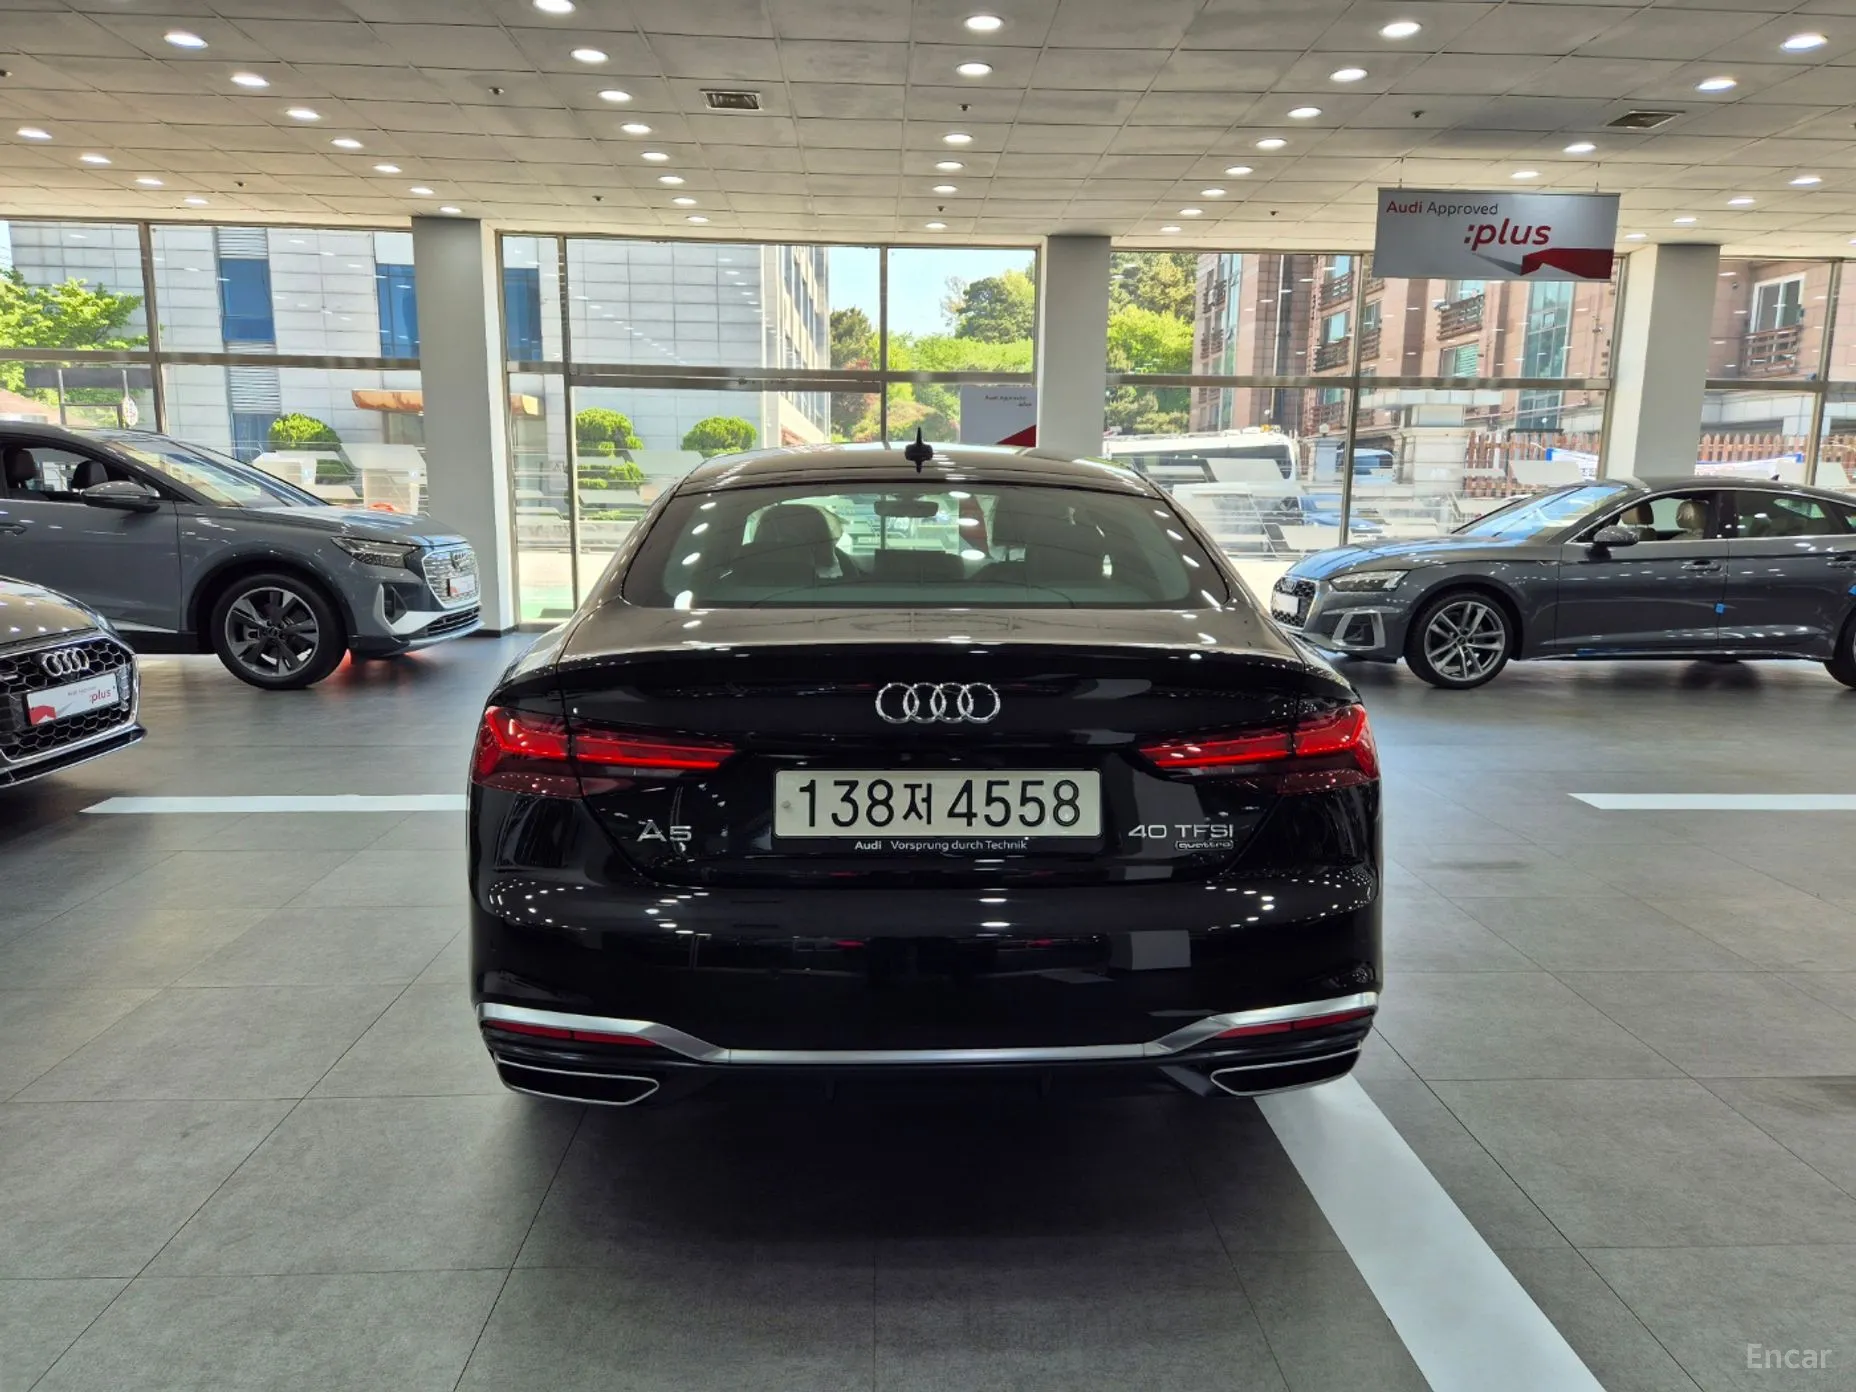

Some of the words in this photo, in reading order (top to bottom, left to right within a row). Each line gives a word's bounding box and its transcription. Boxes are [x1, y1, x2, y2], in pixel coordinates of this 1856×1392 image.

[1386, 201, 1422, 214] Audi
[1426, 202, 1498, 217] Approved
[636, 819, 692, 841] A5
[1128, 824, 1167, 838] 40
[1174, 823, 1234, 838] TFSI
[854, 840, 882, 850] Audi
[891, 840, 949, 852] Vorsprung
[951, 839, 983, 850] durch
[985, 840, 1027, 850] Technik
[1177, 841, 1233, 850] quattro
